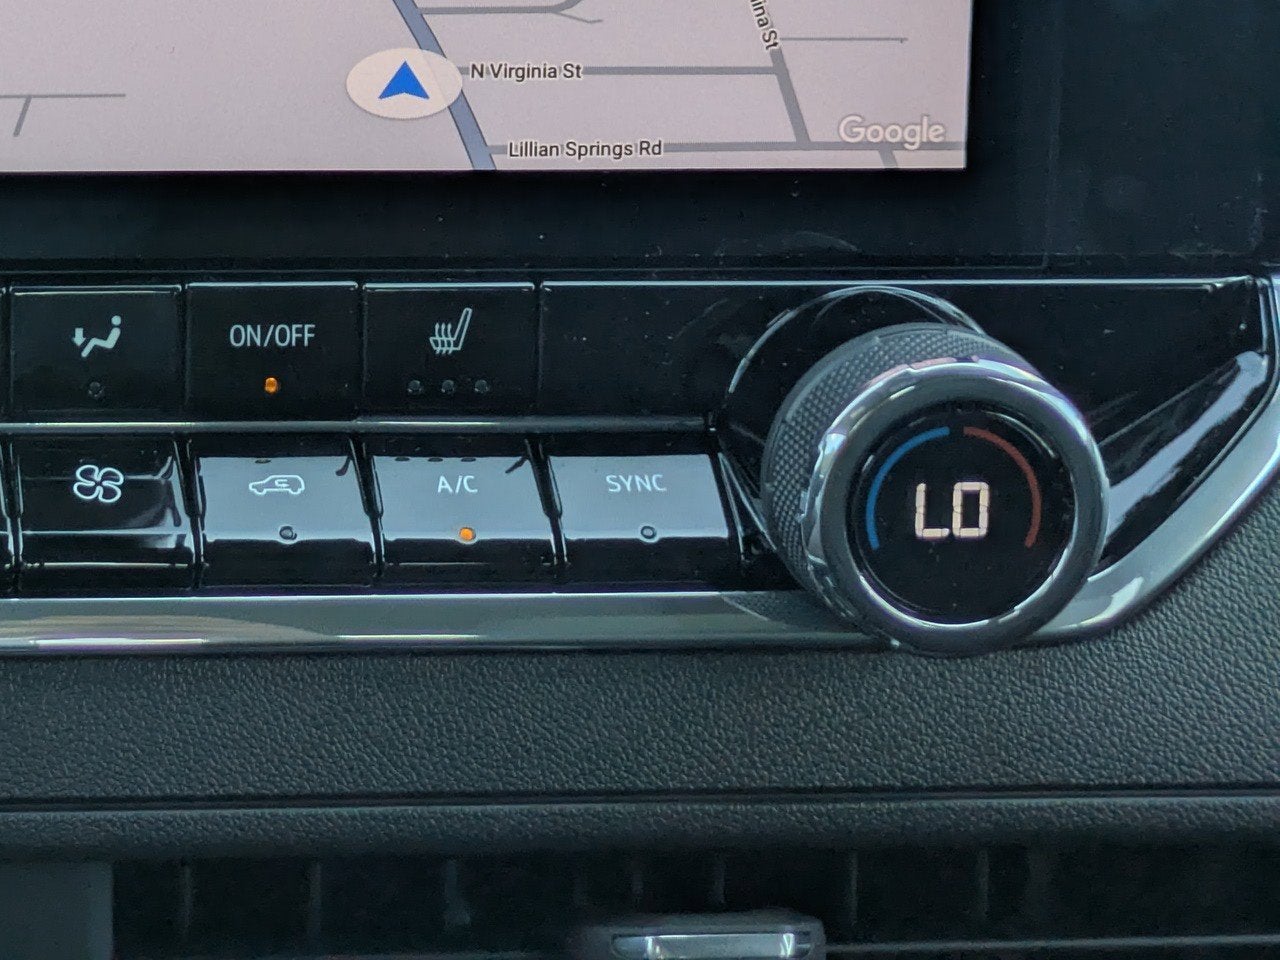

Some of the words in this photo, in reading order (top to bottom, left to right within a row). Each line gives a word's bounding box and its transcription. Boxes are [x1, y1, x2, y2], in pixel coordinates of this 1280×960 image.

[760, 27, 780, 51] St
[470, 63, 486, 79] N
[489, 62, 558, 83] Virginia
[562, 63, 583, 80] St
[838, 115, 946, 150] Google
[508, 140, 562, 158] Lillian
[565, 140, 634, 161] Springs
[639, 139, 663, 157] Rd
[228, 322, 316, 350] ON/OFF
[437, 472, 479, 495] A/C
[605, 471, 669, 495] SYNC
